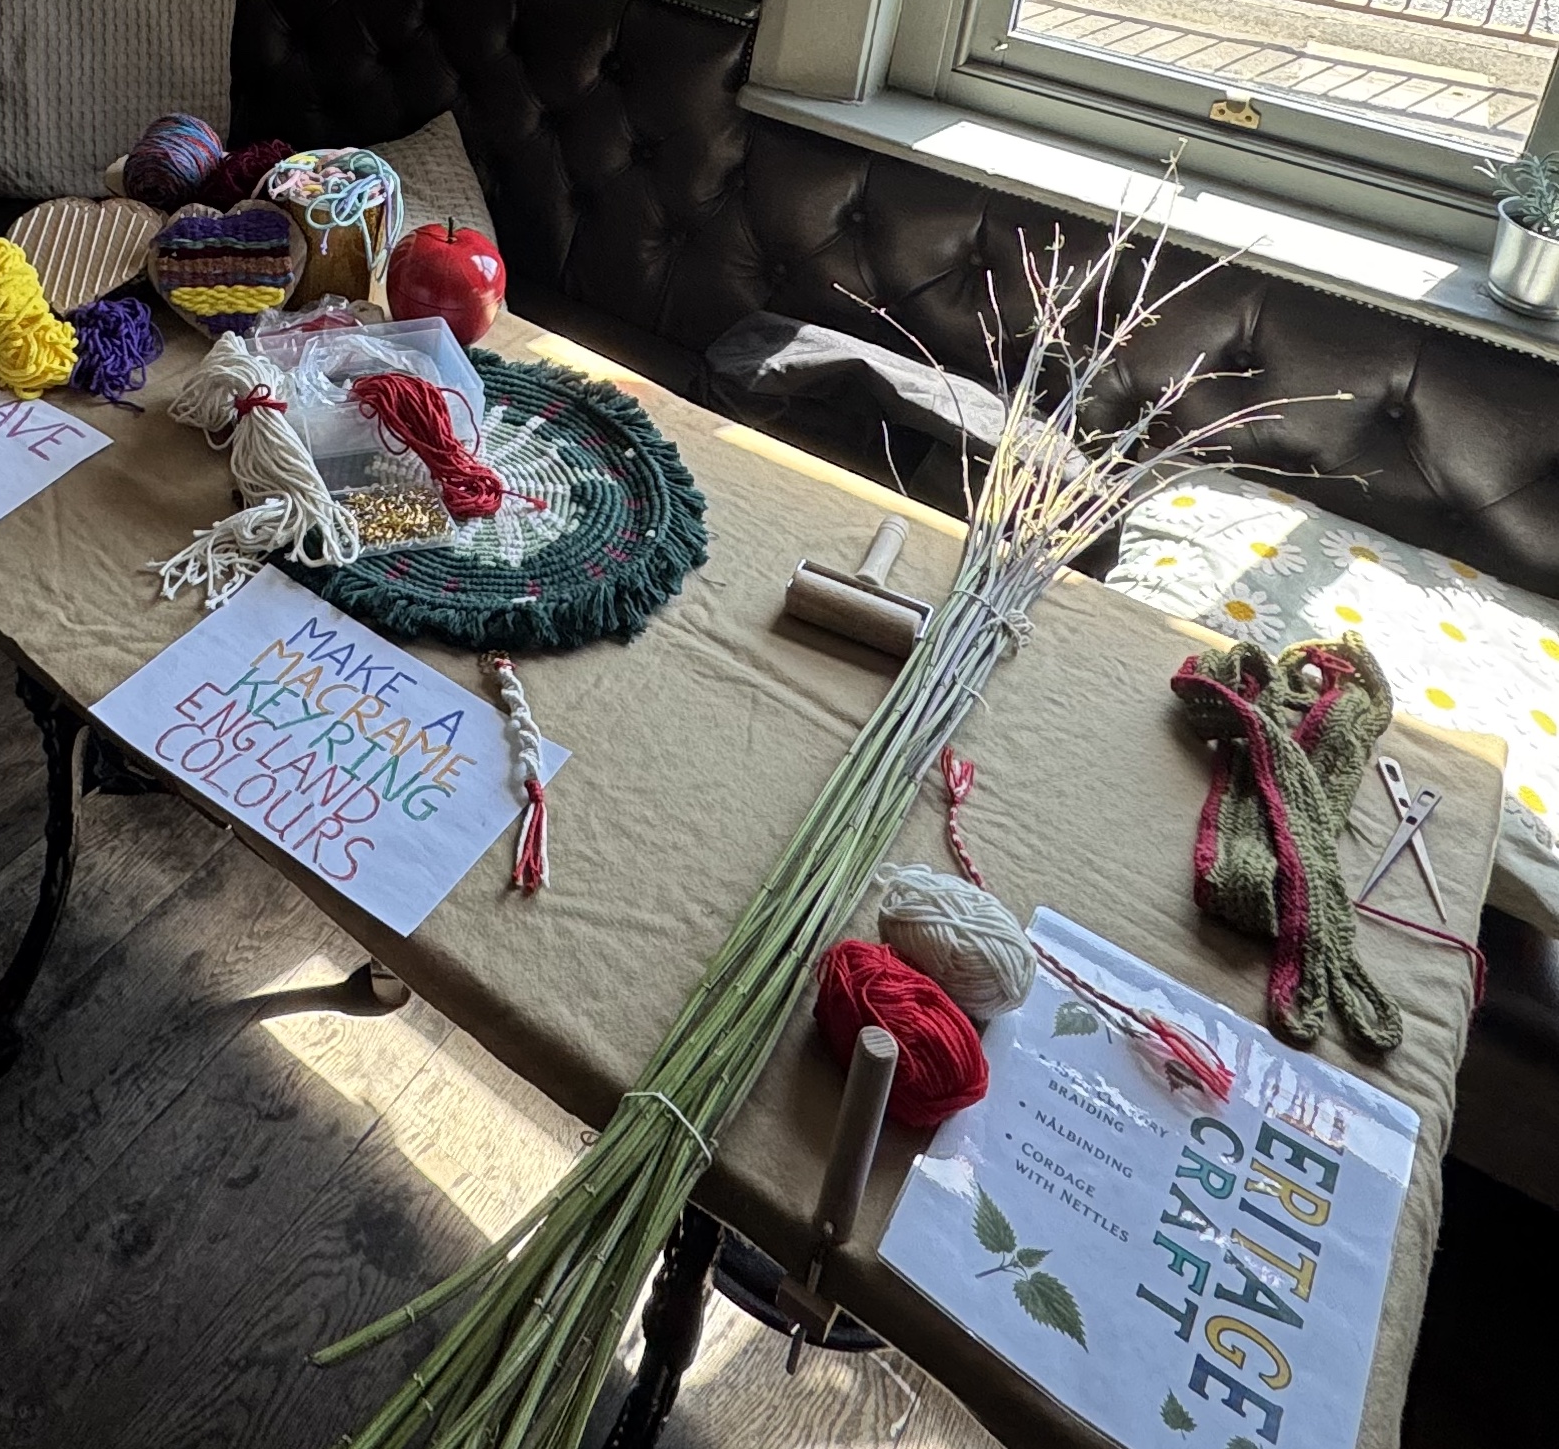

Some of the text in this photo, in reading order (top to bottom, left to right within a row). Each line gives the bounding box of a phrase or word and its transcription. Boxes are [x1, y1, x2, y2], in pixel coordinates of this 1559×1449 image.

[250, 639, 478, 793] MACRAME
[286, 617, 465, 747] MAKE A
[155, 724, 375, 881] COLOURS
[174, 682, 381, 825] ENGLAND
[1021, 1142, 1096, 1198] CORDAGE
[1035, 1110, 1133, 1179] NÅLBINDING
[1048, 1080, 1125, 1133] BRAIDING
[1015, 1159, 1130, 1243] WITH NETTLES
[1136, 1116, 1244, 1343] CRAFT
[1188, 1082, 1346, 1445] ERITAGE
